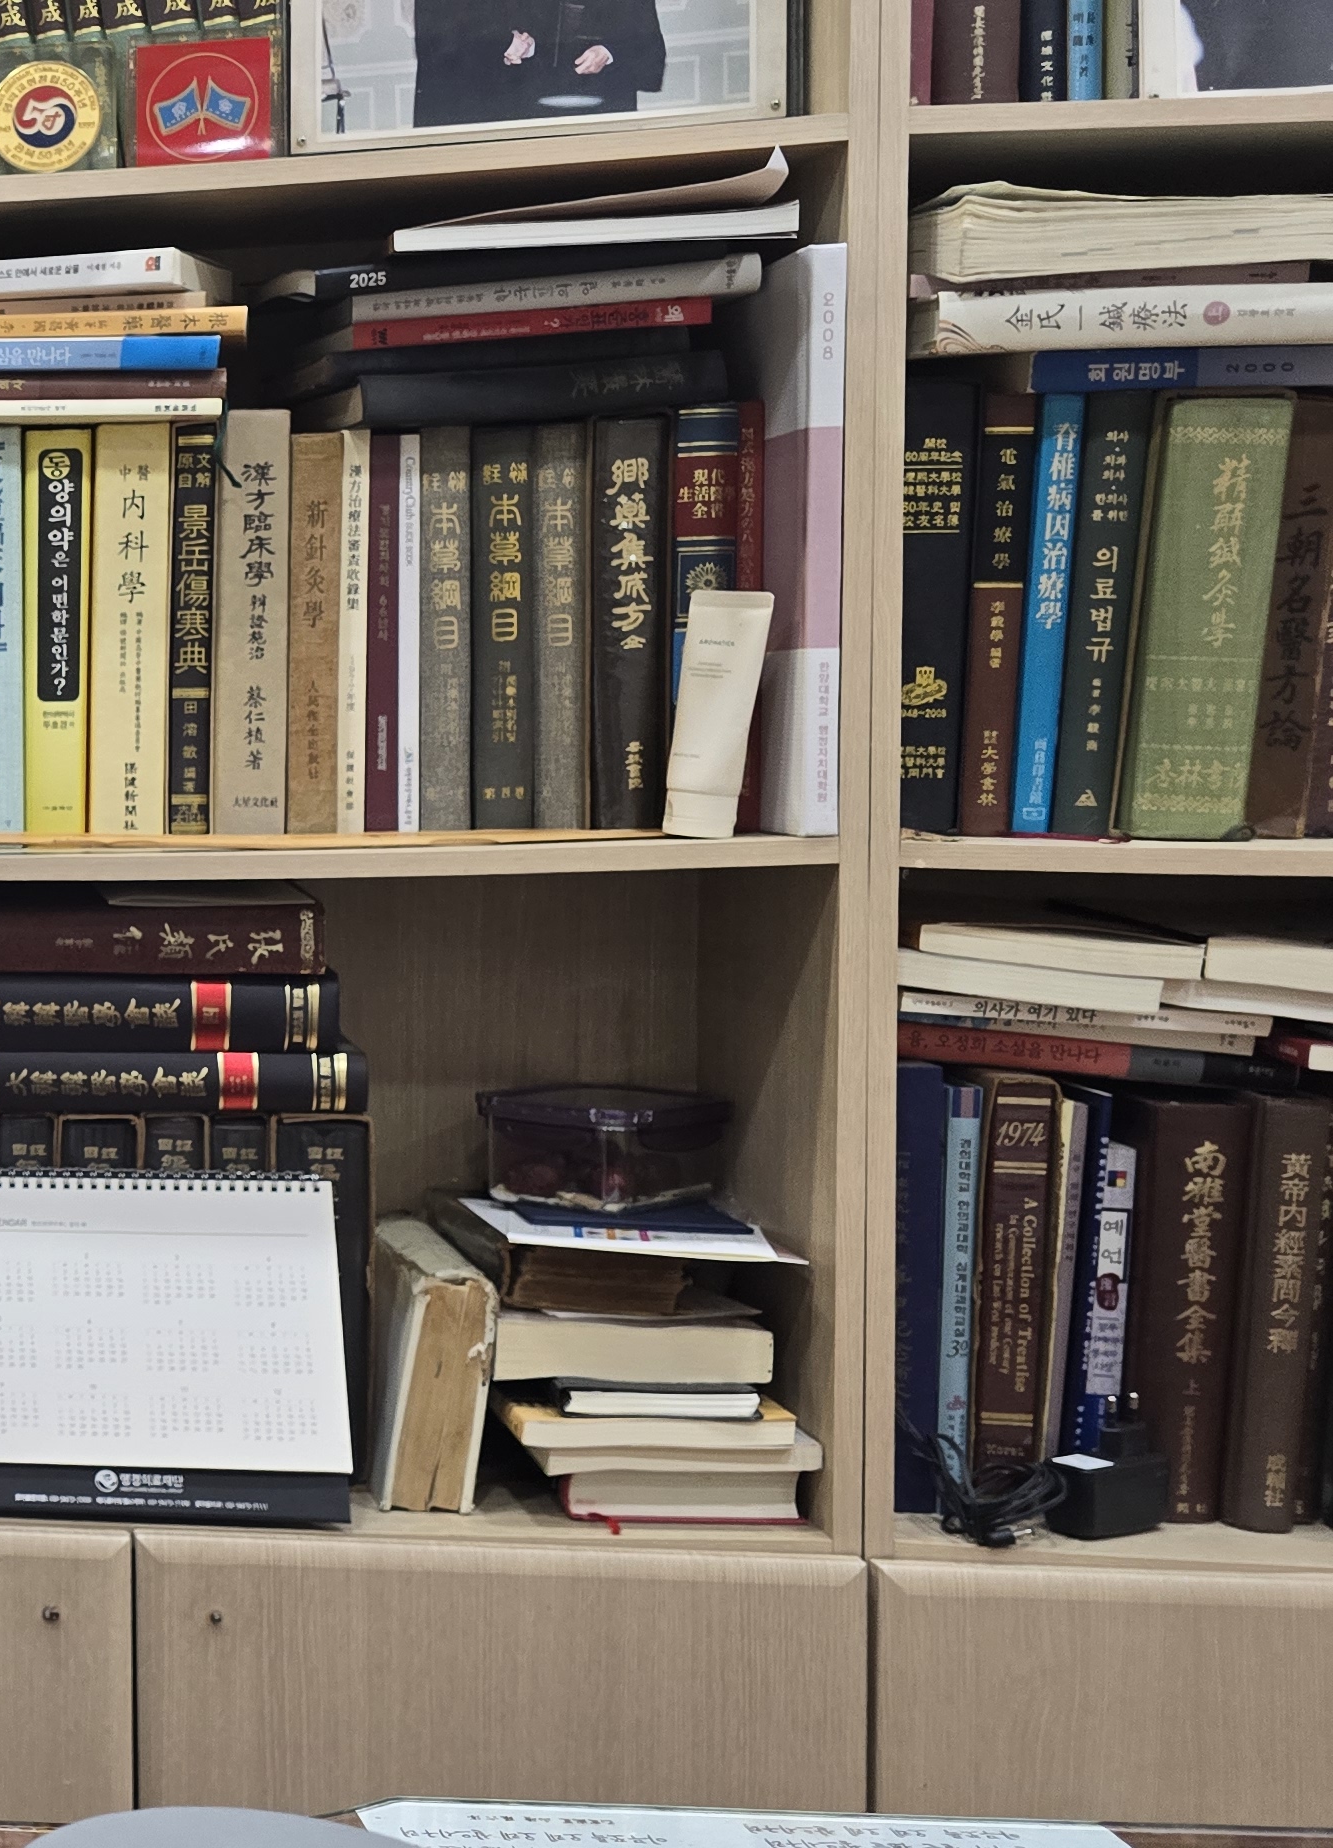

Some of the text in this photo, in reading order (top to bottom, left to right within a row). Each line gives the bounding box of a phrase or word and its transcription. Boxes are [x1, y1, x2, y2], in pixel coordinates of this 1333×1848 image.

[348, 271, 387, 289] 2025
[821, 291, 836, 361] 2008
[26, 347, 72, 366] 만나다
[1088, 361, 1185, 382] 회원명부
[239, 462, 278, 588] 漢方臨床學
[173, 504, 212, 675] 景岳傷寒典
[488, 493, 522, 643] 本草綱目
[1085, 544, 1120, 664] 의료법규
[973, 1000, 1098, 1024] 의사가 여기 있다
[991, 1036, 1103, 1064] 소설을 만나다
[995, 1121, 1047, 1147] 1974
[1019, 1214, 1037, 1298] Collection
